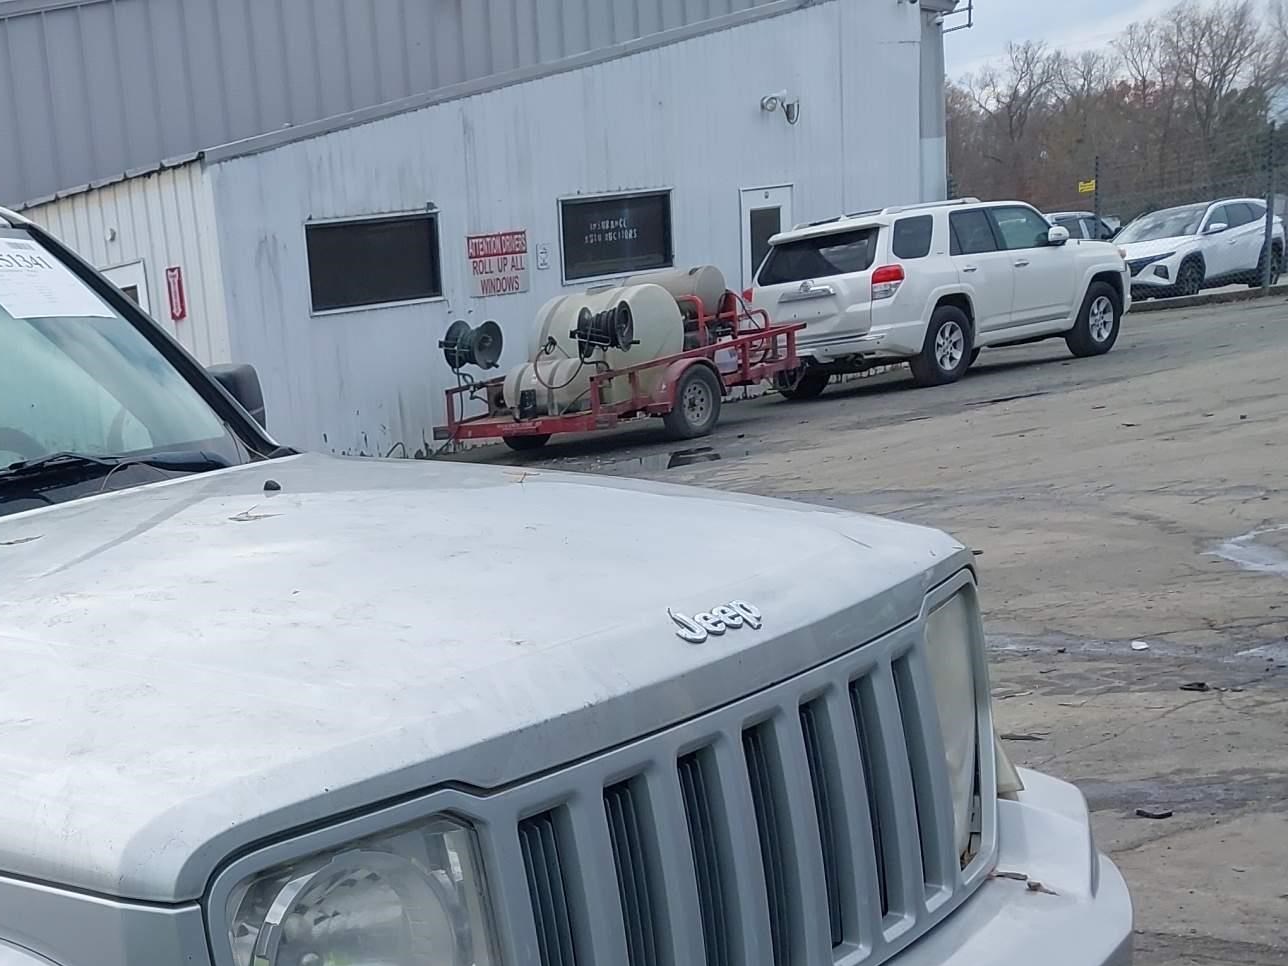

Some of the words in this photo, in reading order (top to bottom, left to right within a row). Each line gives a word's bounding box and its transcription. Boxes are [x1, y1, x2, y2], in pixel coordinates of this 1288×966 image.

[468, 236, 502, 257] ATTENTION
[501, 233, 526, 254] DRIVERS
[472, 258, 495, 276] ROLL
[497, 257, 508, 273] UP
[510, 255, 525, 271] ALL
[480, 275, 520, 295] WINDOWS
[665, 599, 762, 644] Jeep
